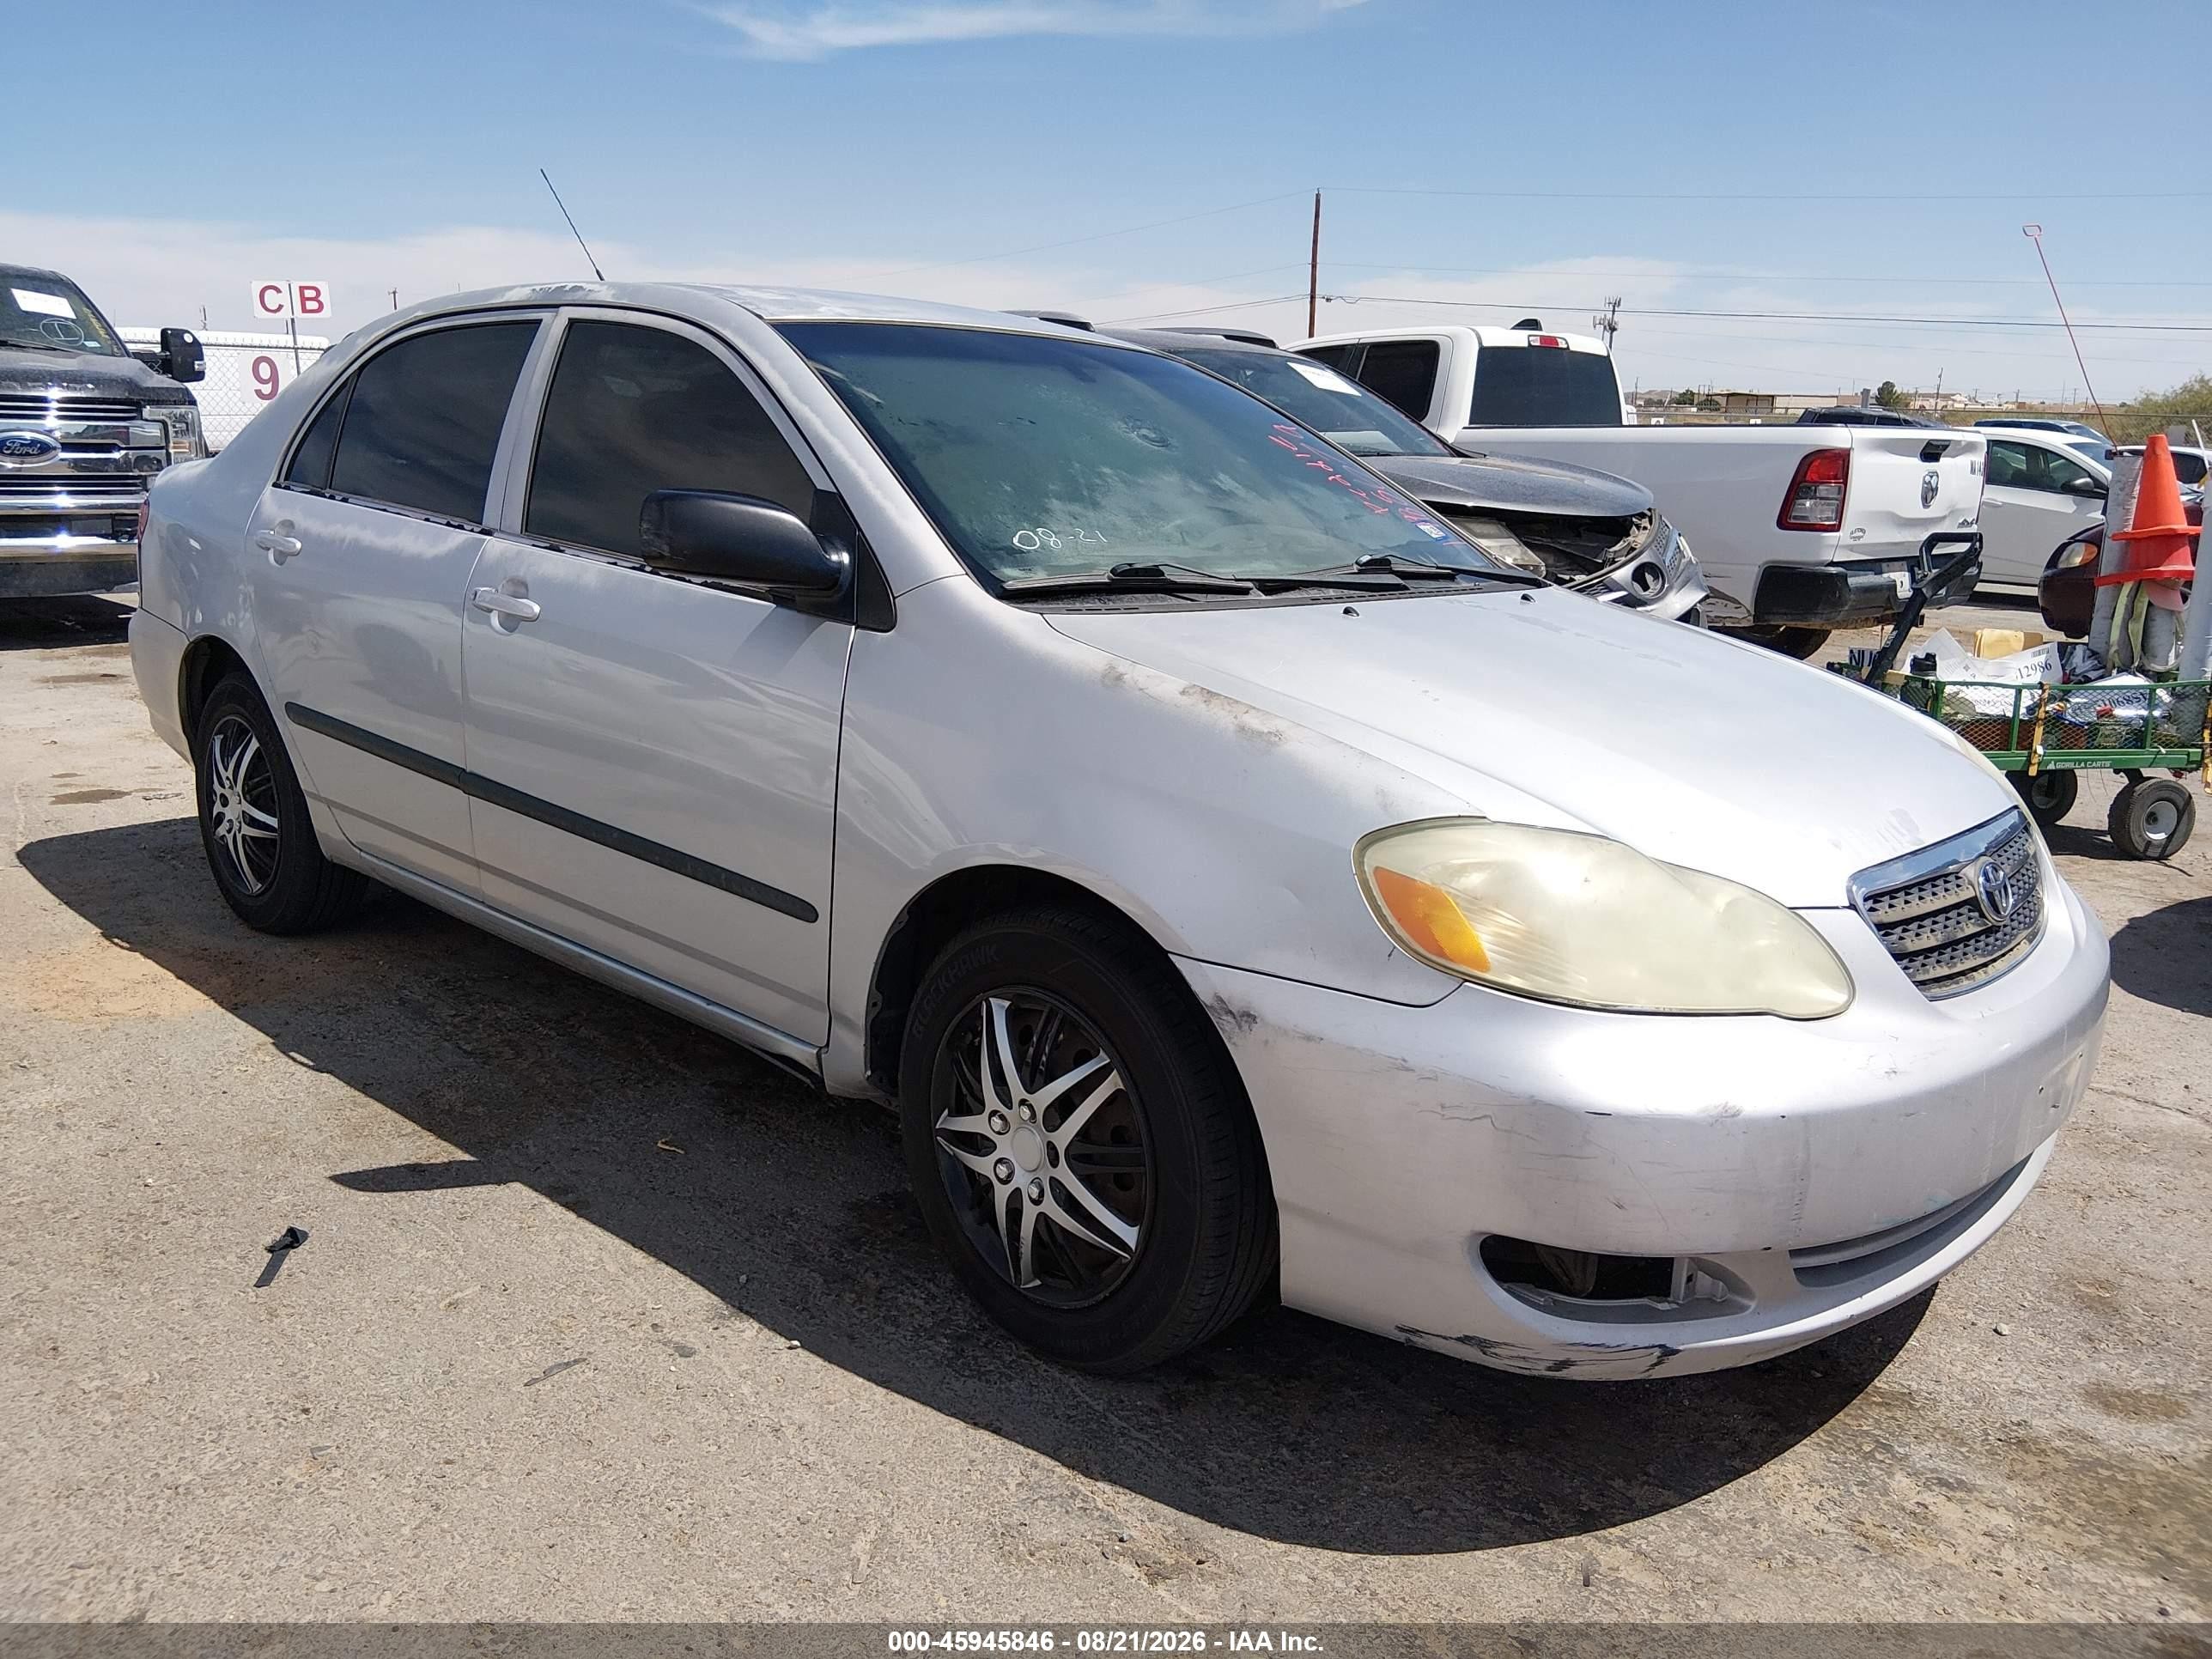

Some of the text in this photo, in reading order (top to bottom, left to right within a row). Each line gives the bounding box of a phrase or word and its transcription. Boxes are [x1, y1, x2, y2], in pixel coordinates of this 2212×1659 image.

[258, 284, 284, 314] C
[298, 285, 325, 314] B
[252, 356, 280, 401] 9
[3, 439, 41, 454] Ford
[1012, 527, 1109, 550] 08-21
[2015, 658, 2053, 680] 12986
[2055, 760, 2112, 769] GORILLA CARTS
